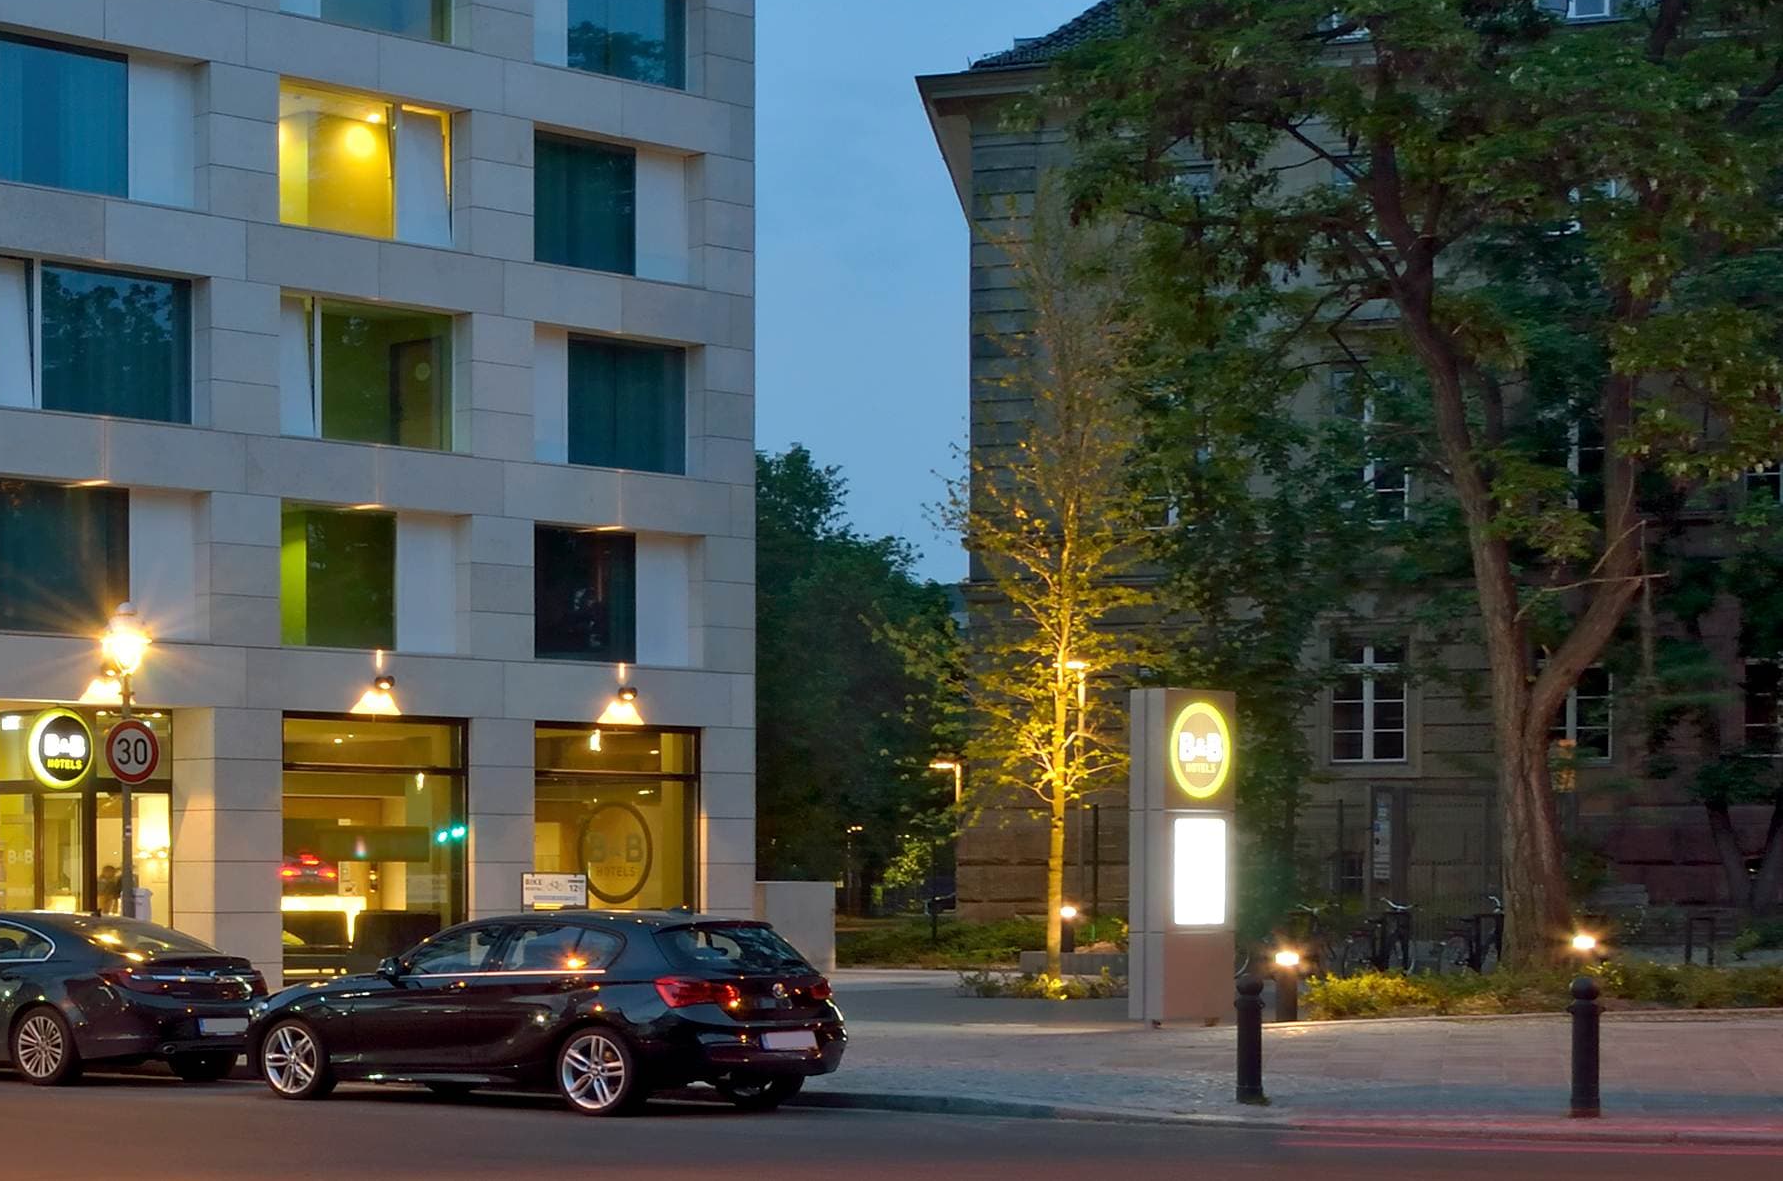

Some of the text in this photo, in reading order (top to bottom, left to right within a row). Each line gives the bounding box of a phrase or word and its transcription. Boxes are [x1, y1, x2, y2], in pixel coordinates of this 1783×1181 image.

[43, 733, 85, 758] B&B
[117, 737, 148, 766] 30
[1178, 732, 1223, 762] B&B
[47, 758, 83, 770] HOTELS
[595, 866, 636, 877] HOTELS
